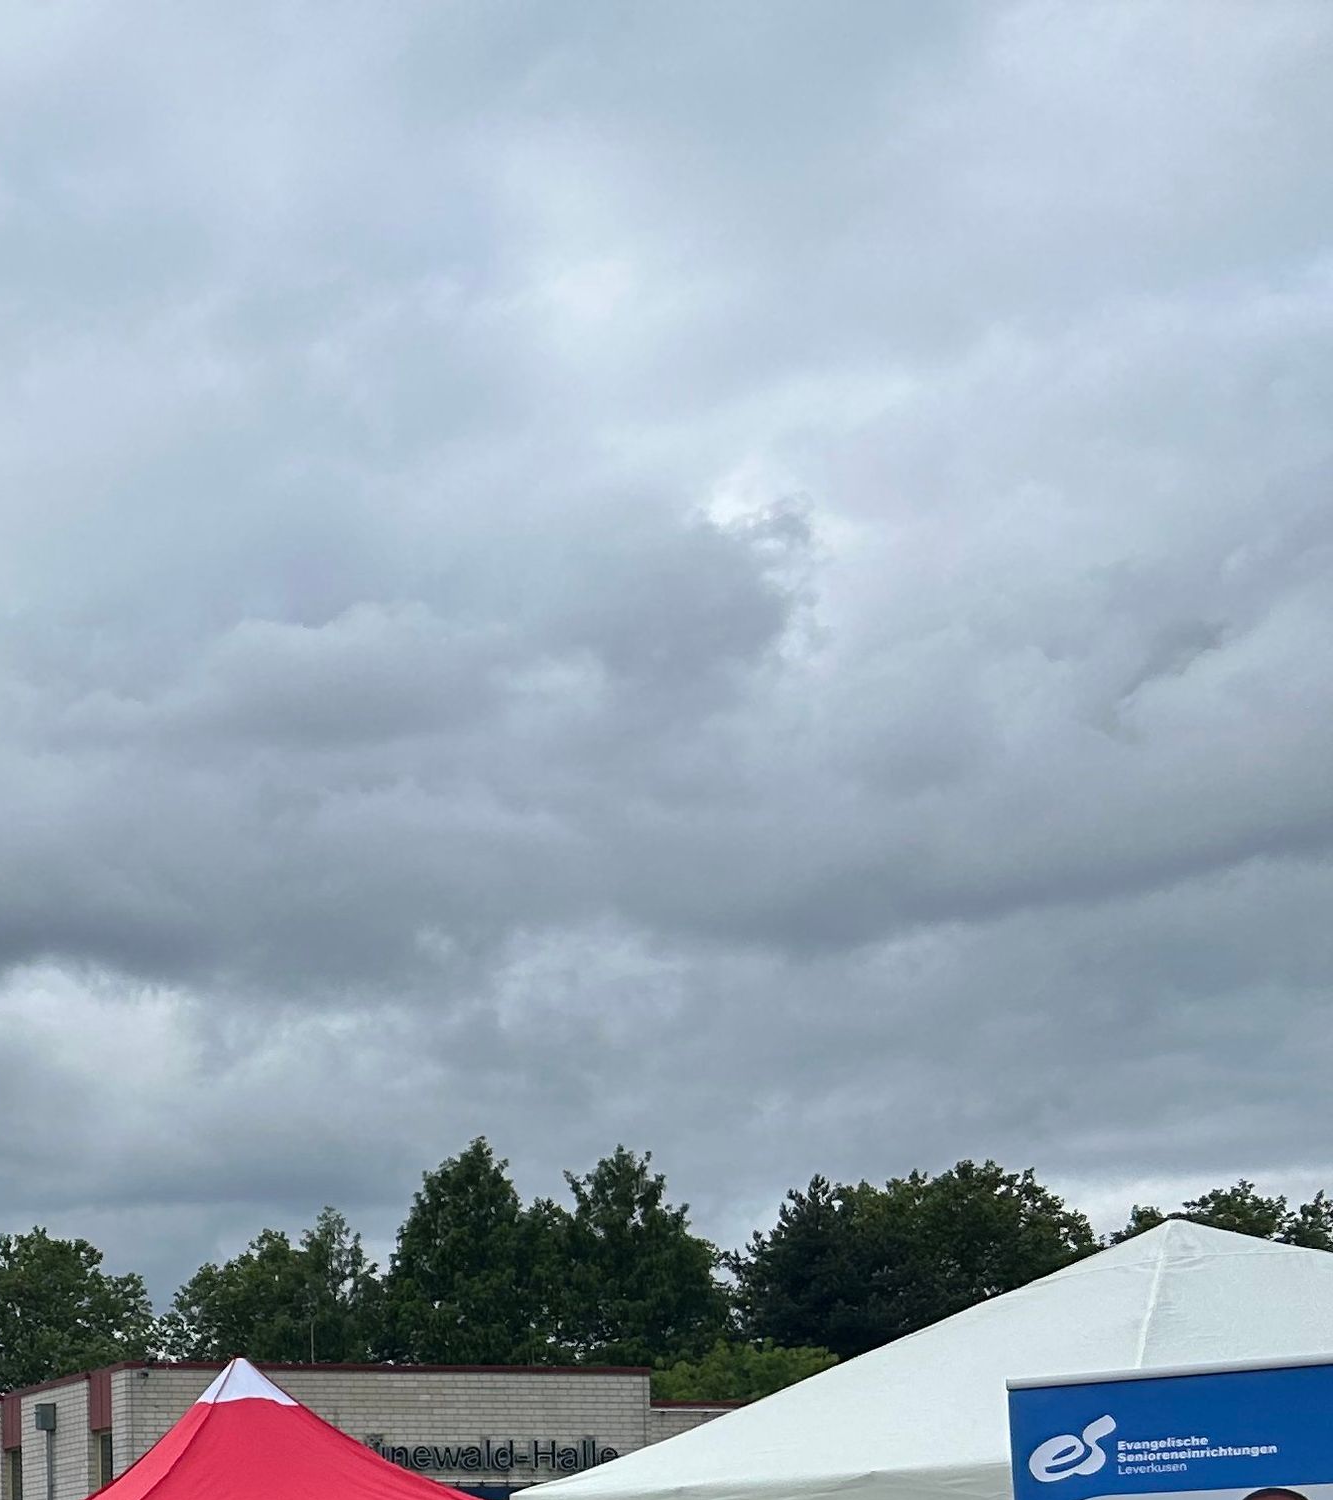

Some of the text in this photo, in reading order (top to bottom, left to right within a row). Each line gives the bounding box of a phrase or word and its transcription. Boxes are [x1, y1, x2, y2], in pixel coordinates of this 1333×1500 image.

[1117, 1436, 1209, 1450] Evangelische
[1117, 1445, 1278, 1462] Senioreneinrichtungen
[1118, 1463, 1187, 1475] Leverkusen
